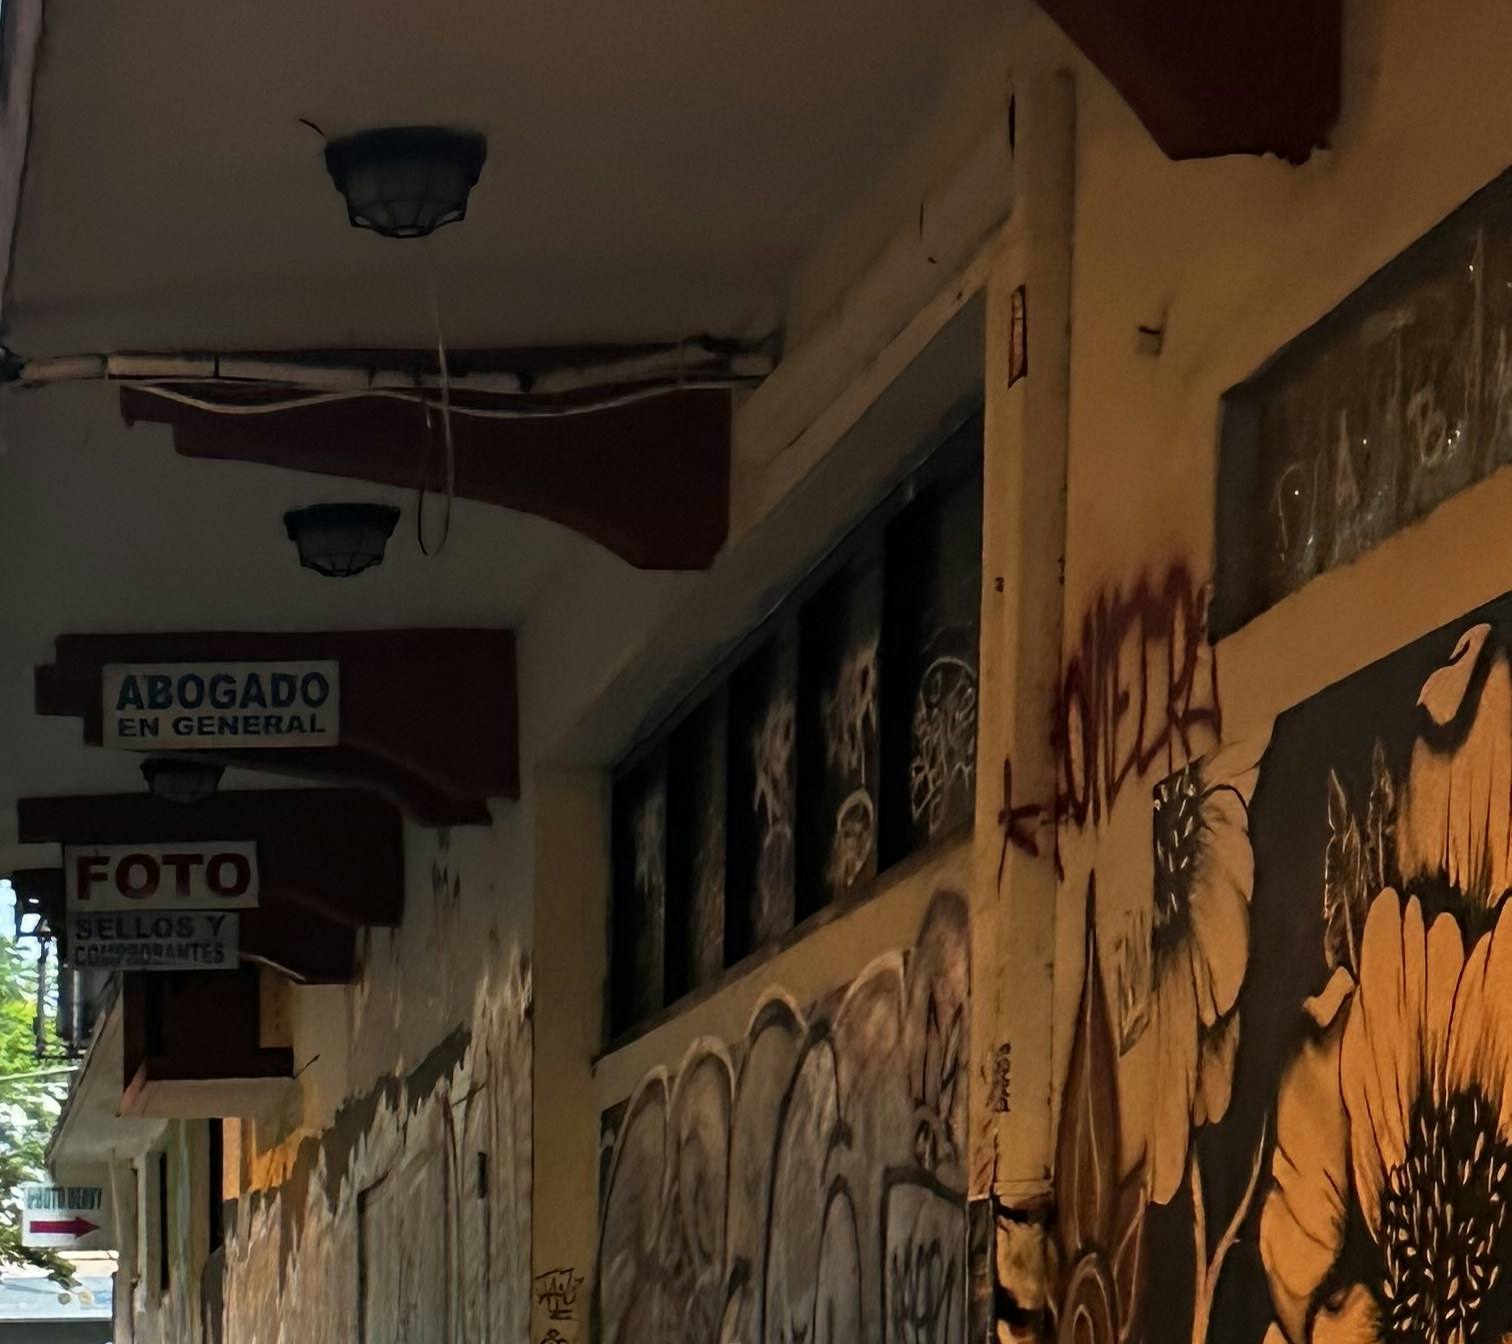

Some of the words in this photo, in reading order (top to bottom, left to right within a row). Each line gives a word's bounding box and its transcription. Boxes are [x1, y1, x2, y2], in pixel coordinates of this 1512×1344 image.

[115, 671, 330, 711] ABOGADO
[117, 717, 160, 738] EN
[171, 713, 326, 737] GENERAL
[75, 852, 251, 901] FOTO
[75, 914, 196, 941] SELLOS
[207, 913, 226, 938] Y
